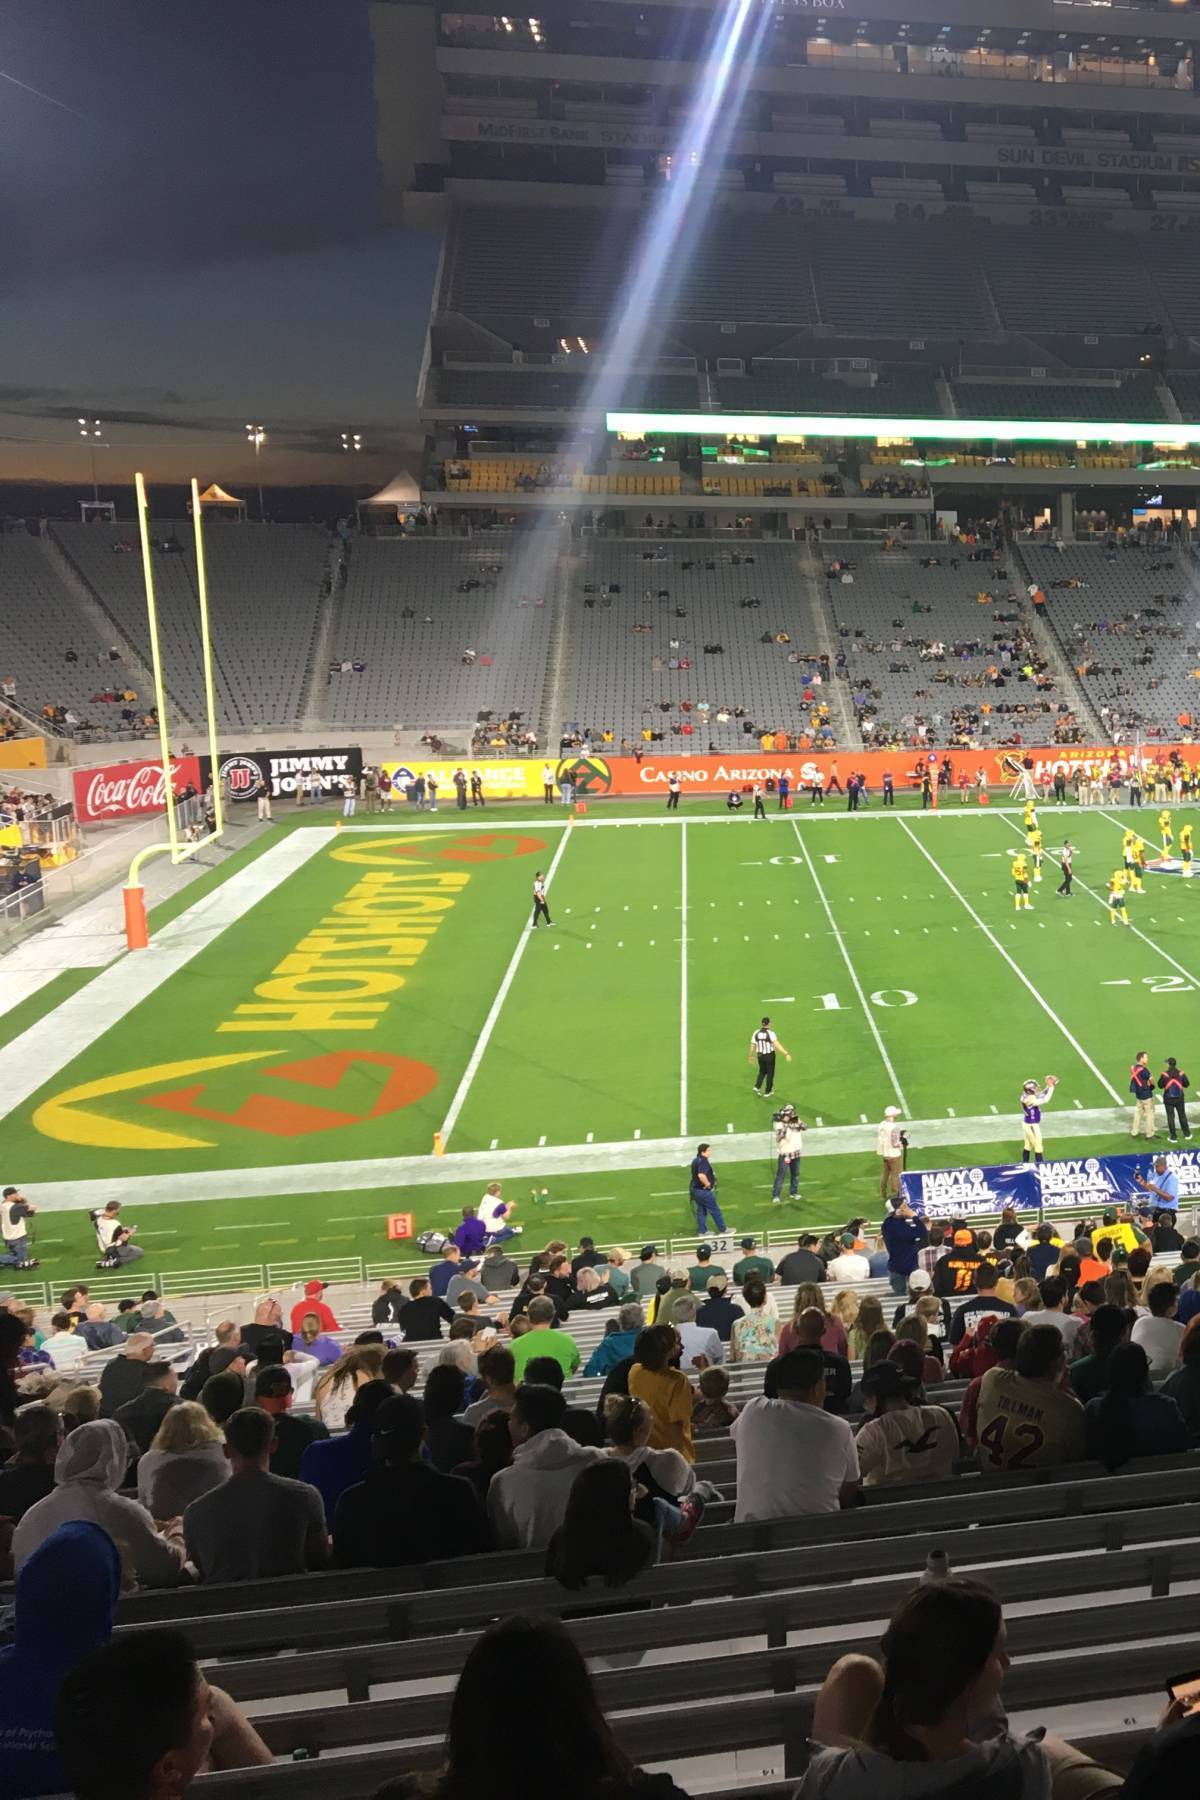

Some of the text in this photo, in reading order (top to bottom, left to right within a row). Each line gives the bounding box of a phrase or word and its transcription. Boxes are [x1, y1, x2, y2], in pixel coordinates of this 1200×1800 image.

[997, 148, 1035, 163] SUN
[1041, 150, 1091, 166] DEVIL
[1097, 153, 1172, 170] STADIUM
[269, 755, 349, 777] JIMMY
[230, 768, 251, 789] JJ
[216, 871, 471, 1032] HOTSHOTS
[811, 989, 919, 1012] 10
[1039, 1159, 1083, 1178] NAVY
[921, 1170, 970, 1189] NAVY
[1041, 1171, 1108, 1190] FEDERAL
[922, 1183, 992, 1201] FEDERAL
[1041, 1189, 1110, 1207] Credit Union
[963, 1199, 996, 1214] Union
[394, 1218, 408, 1236] G
[711, 1240, 727, 1252] 32
[998, 1394, 1046, 1422] TILLMAN
[981, 1415, 1045, 1470] 42
